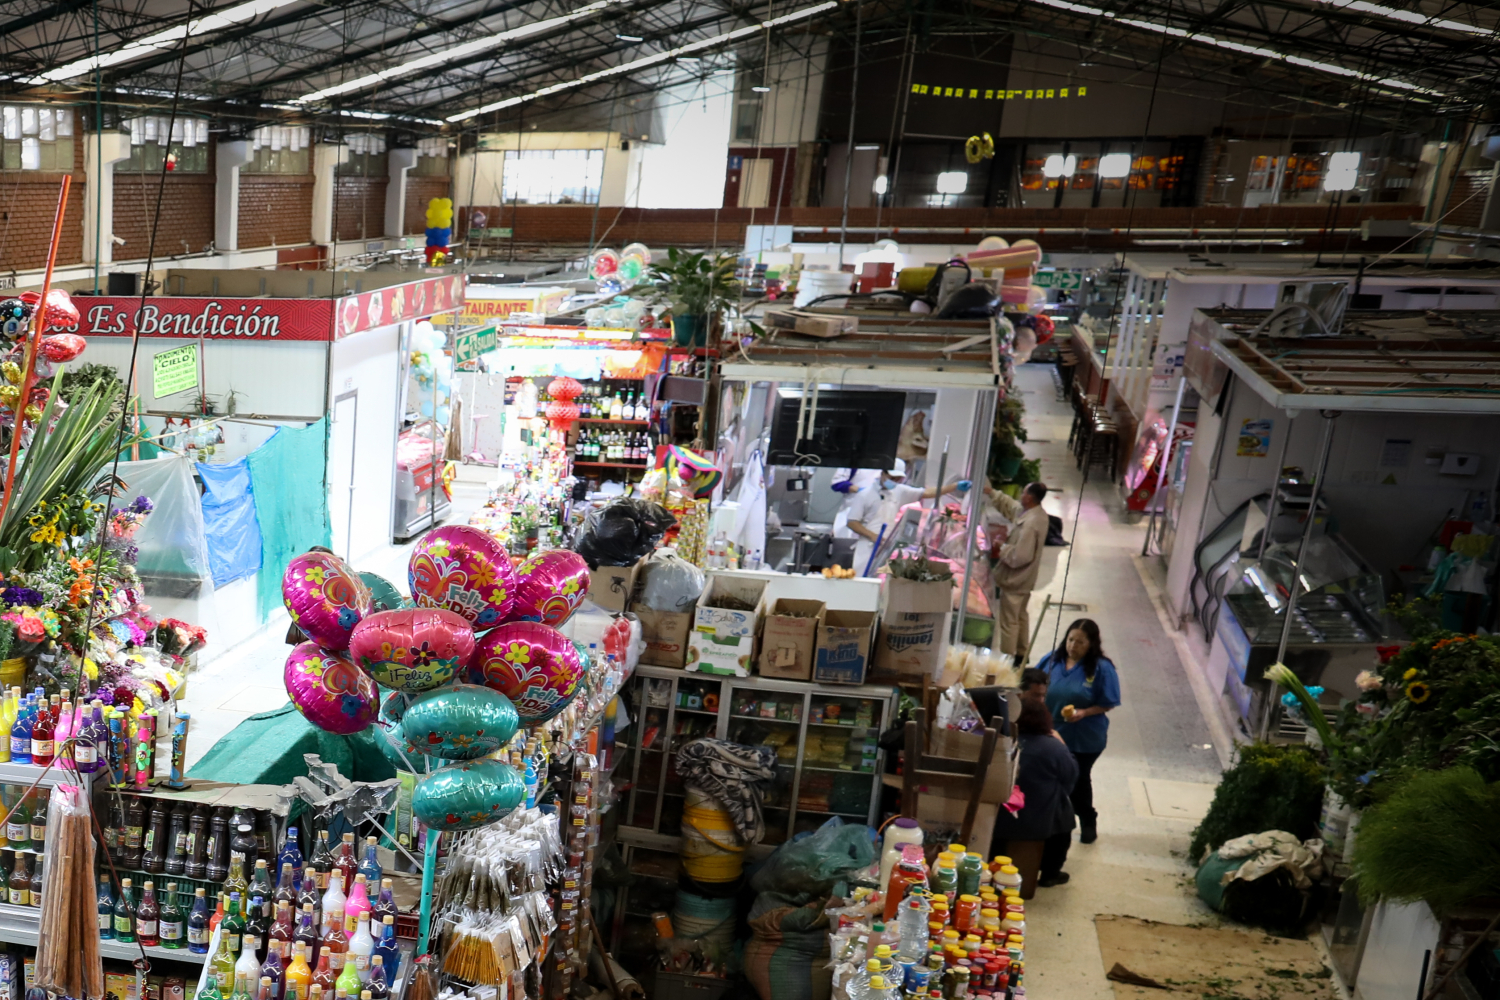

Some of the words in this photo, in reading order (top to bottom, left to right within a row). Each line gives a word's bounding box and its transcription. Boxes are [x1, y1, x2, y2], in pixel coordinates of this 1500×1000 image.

[88, 305, 127, 334] Es
[134, 301, 280, 337] Bendición
[478, 332, 495, 350] SALIDA
[161, 355, 190, 368] CIELO
[449, 584, 485, 610] Feliz
[451, 602, 477, 621] Día
[886, 633, 934, 650] familia
[526, 686, 561, 704] Feliz
[523, 699, 550, 712] Día
